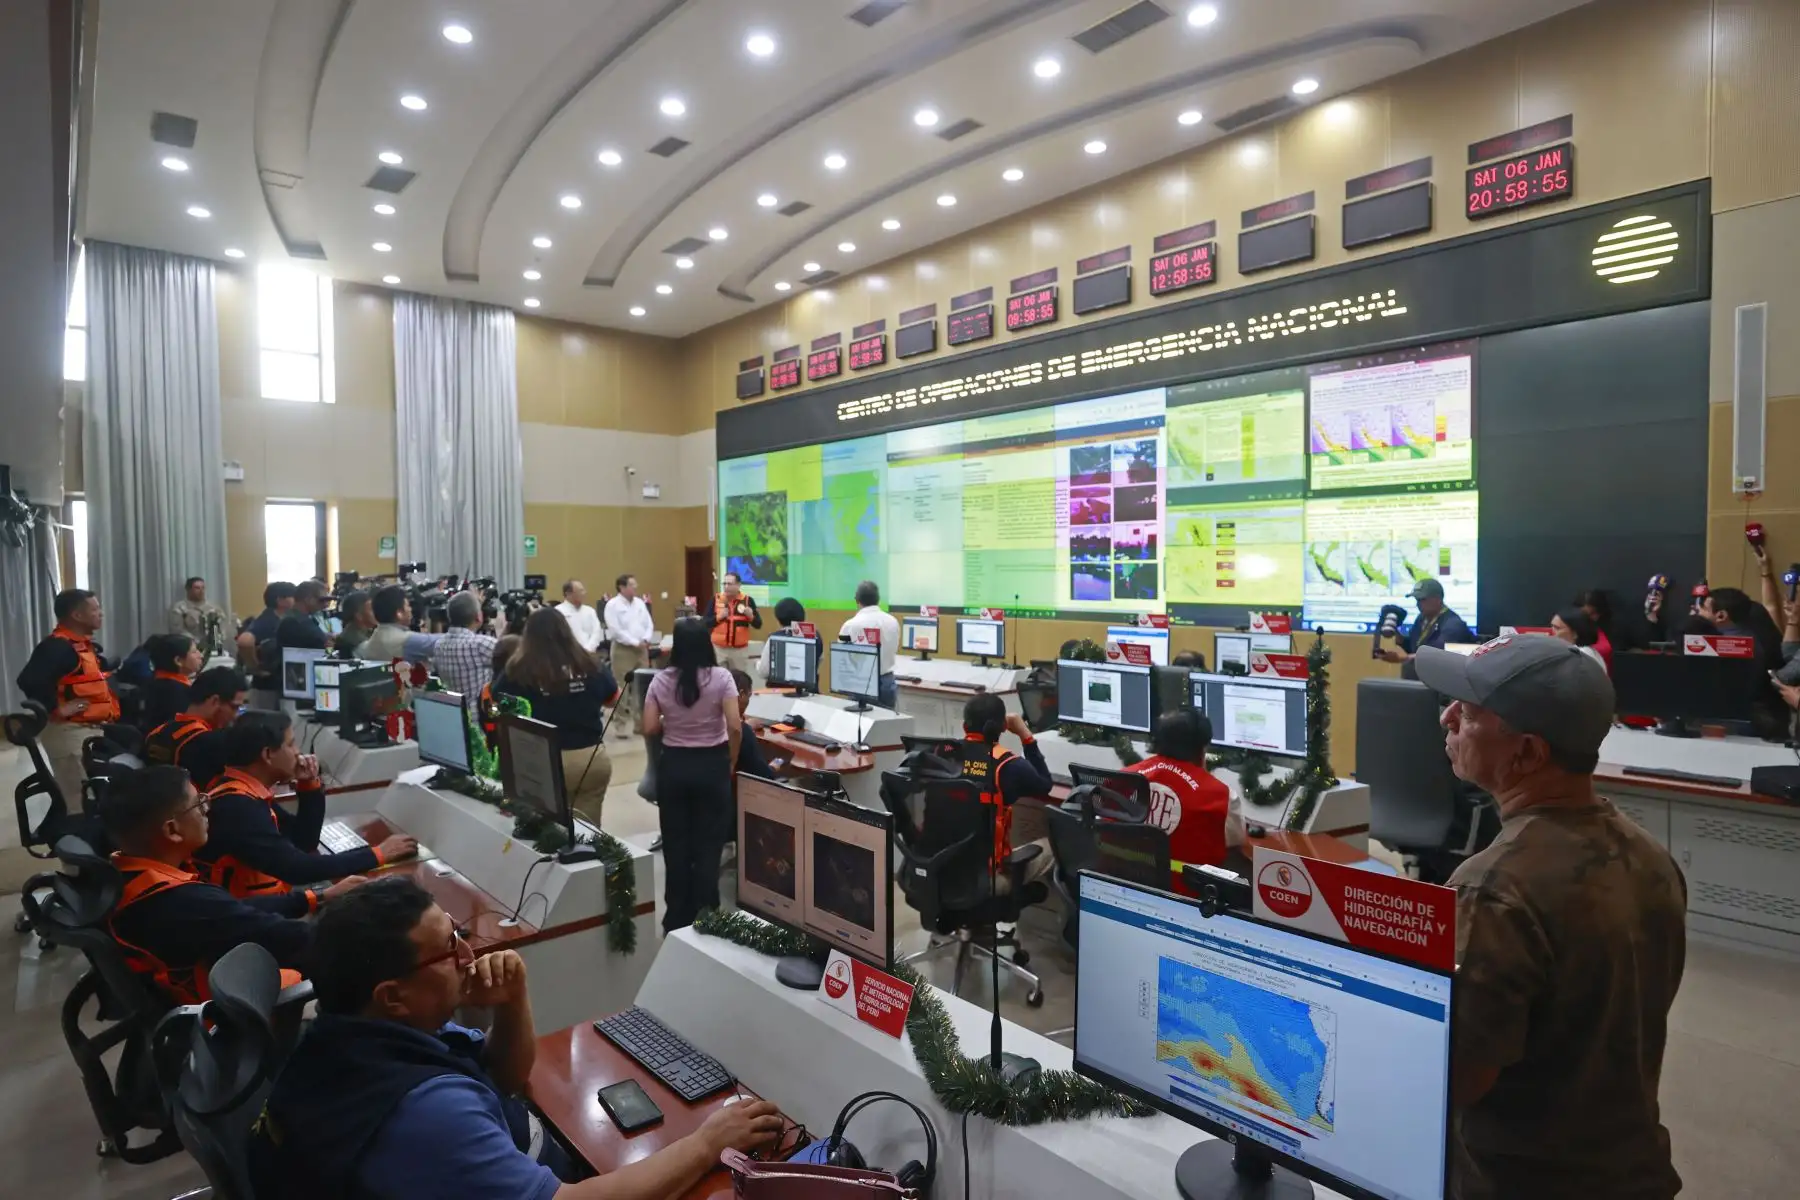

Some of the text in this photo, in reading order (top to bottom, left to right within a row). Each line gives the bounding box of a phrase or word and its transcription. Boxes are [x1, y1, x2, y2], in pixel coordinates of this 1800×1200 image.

[1474, 150, 1561, 187] SAT 06 JAN
[1469, 170, 1567, 212] 20:58:55
[1153, 247, 1208, 273] SAT 06 JAN
[1151, 262, 1212, 290] 12:58:55
[1007, 303, 1054, 326] 09:58:55
[837, 290, 1407, 420] CENTRO DE OPERACIONES DE EMERGENCIA NACIONAL
[973, 761, 988, 770] CIVIL
[1157, 762, 1174, 771] Civil
[1269, 890, 1299, 905] COEN
[1344, 886, 1435, 918] DIRECCIÓN DE
[1344, 901, 1447, 936] HIDROGRAFÍA Y
[1344, 916, 1428, 947] NAVEGACIÓN
[829, 979, 843, 990] COEN
[864, 976, 910, 1003] SERVICIO NACIONAL
[857, 1001, 867, 1011] DEL
